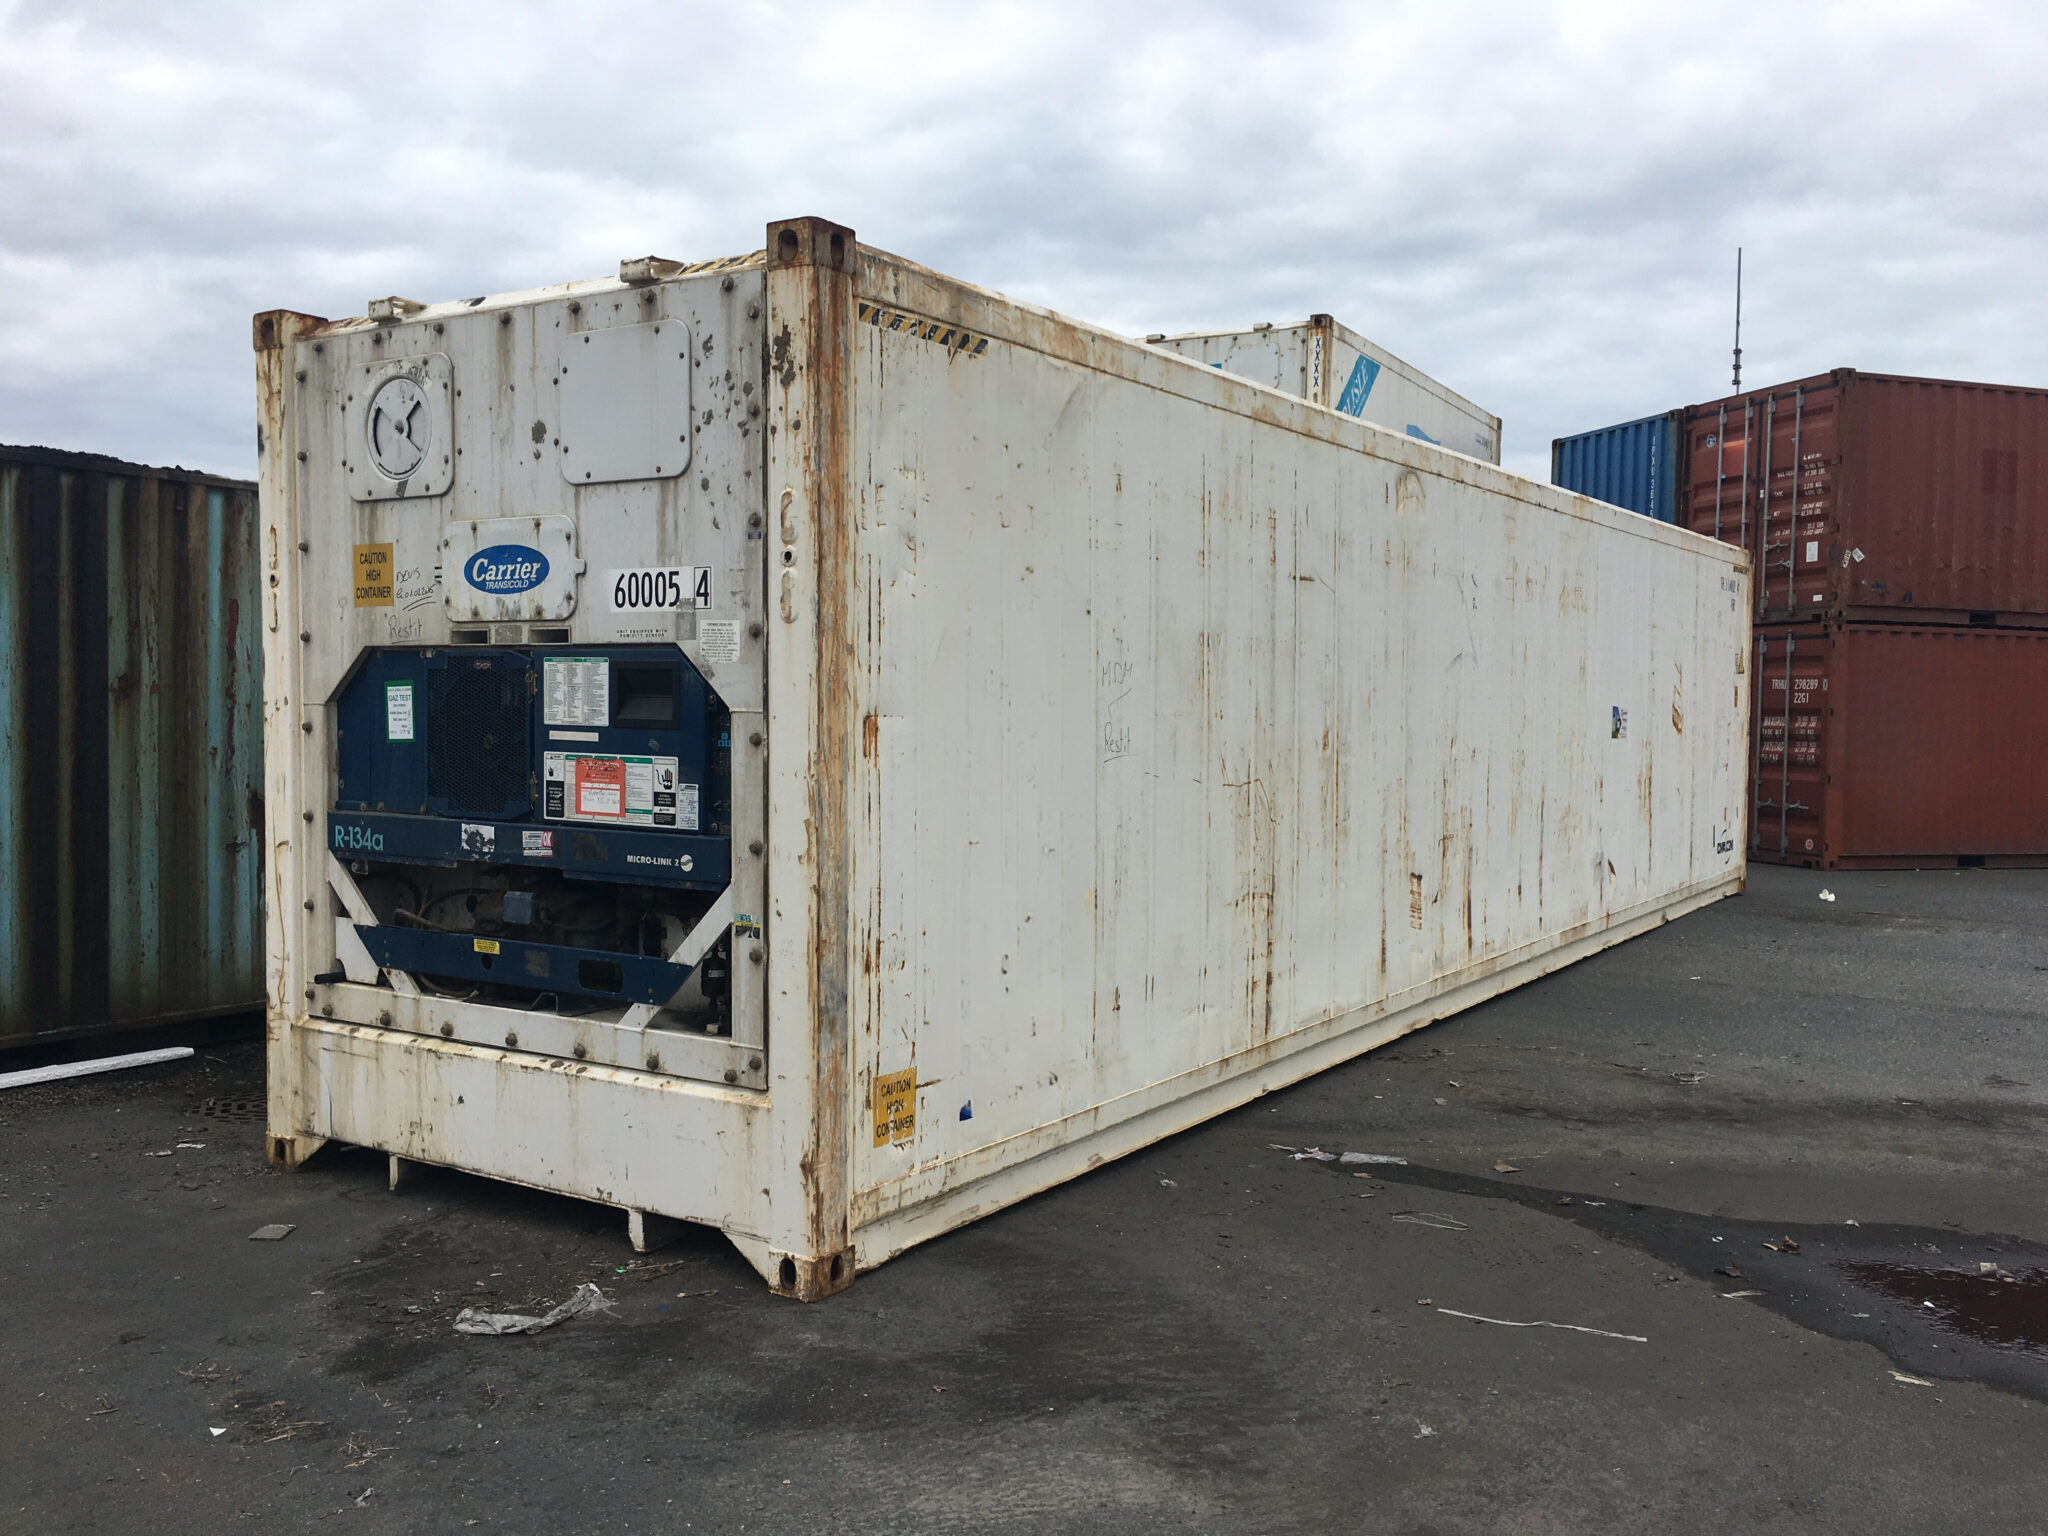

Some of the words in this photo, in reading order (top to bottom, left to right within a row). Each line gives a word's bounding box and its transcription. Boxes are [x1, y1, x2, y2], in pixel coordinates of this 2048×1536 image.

[360, 551, 387, 565] CAUTION
[366, 569, 381, 582] HIGH
[472, 557, 541, 582] Carrier
[356, 586, 392, 599] CONTAINER
[615, 570, 680, 608] 60005
[696, 569, 710, 607] 4
[1794, 678, 1819, 690] 298289
[399, 694, 411, 702] TEST
[334, 824, 384, 851] R-134a
[543, 831, 553, 847] OK
[626, 854, 672, 867] MICRO-LINK
[881, 1077, 911, 1097] CAUTION
